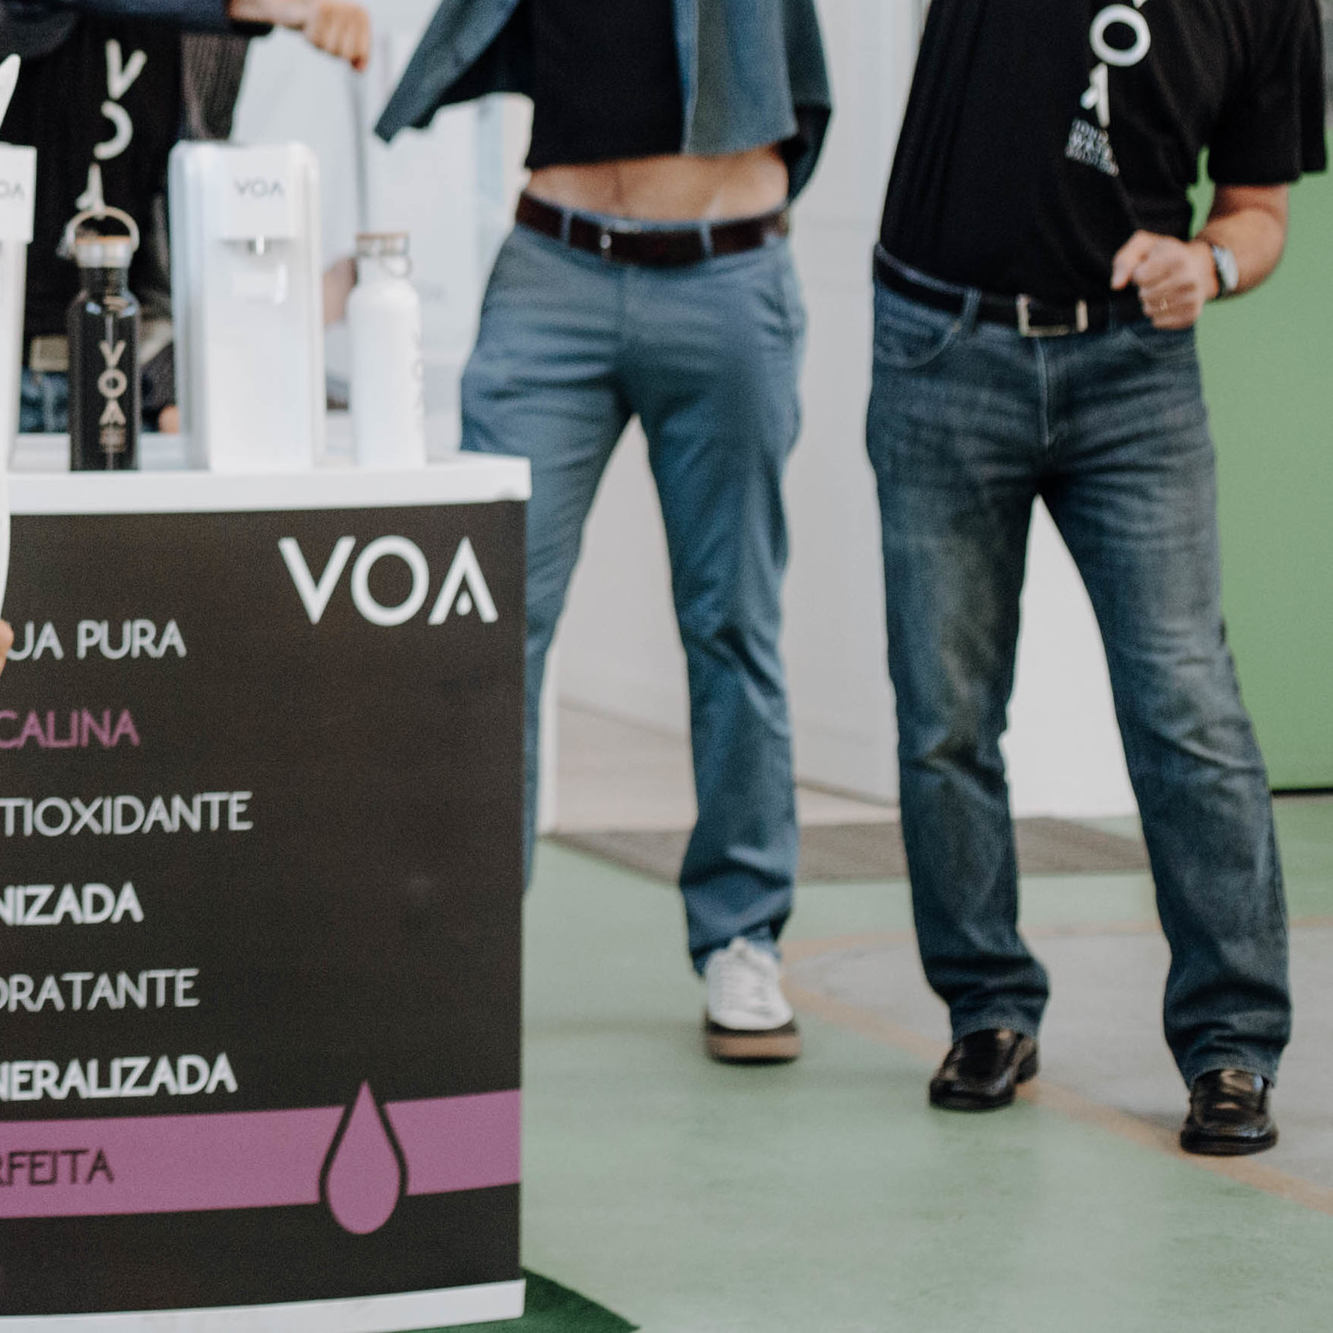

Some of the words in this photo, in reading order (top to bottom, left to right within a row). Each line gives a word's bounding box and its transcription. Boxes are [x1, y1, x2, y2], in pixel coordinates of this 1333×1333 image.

[98, 339, 127, 425] VOA
[277, 534, 499, 627] VOA
[76, 617, 188, 661] PURA
